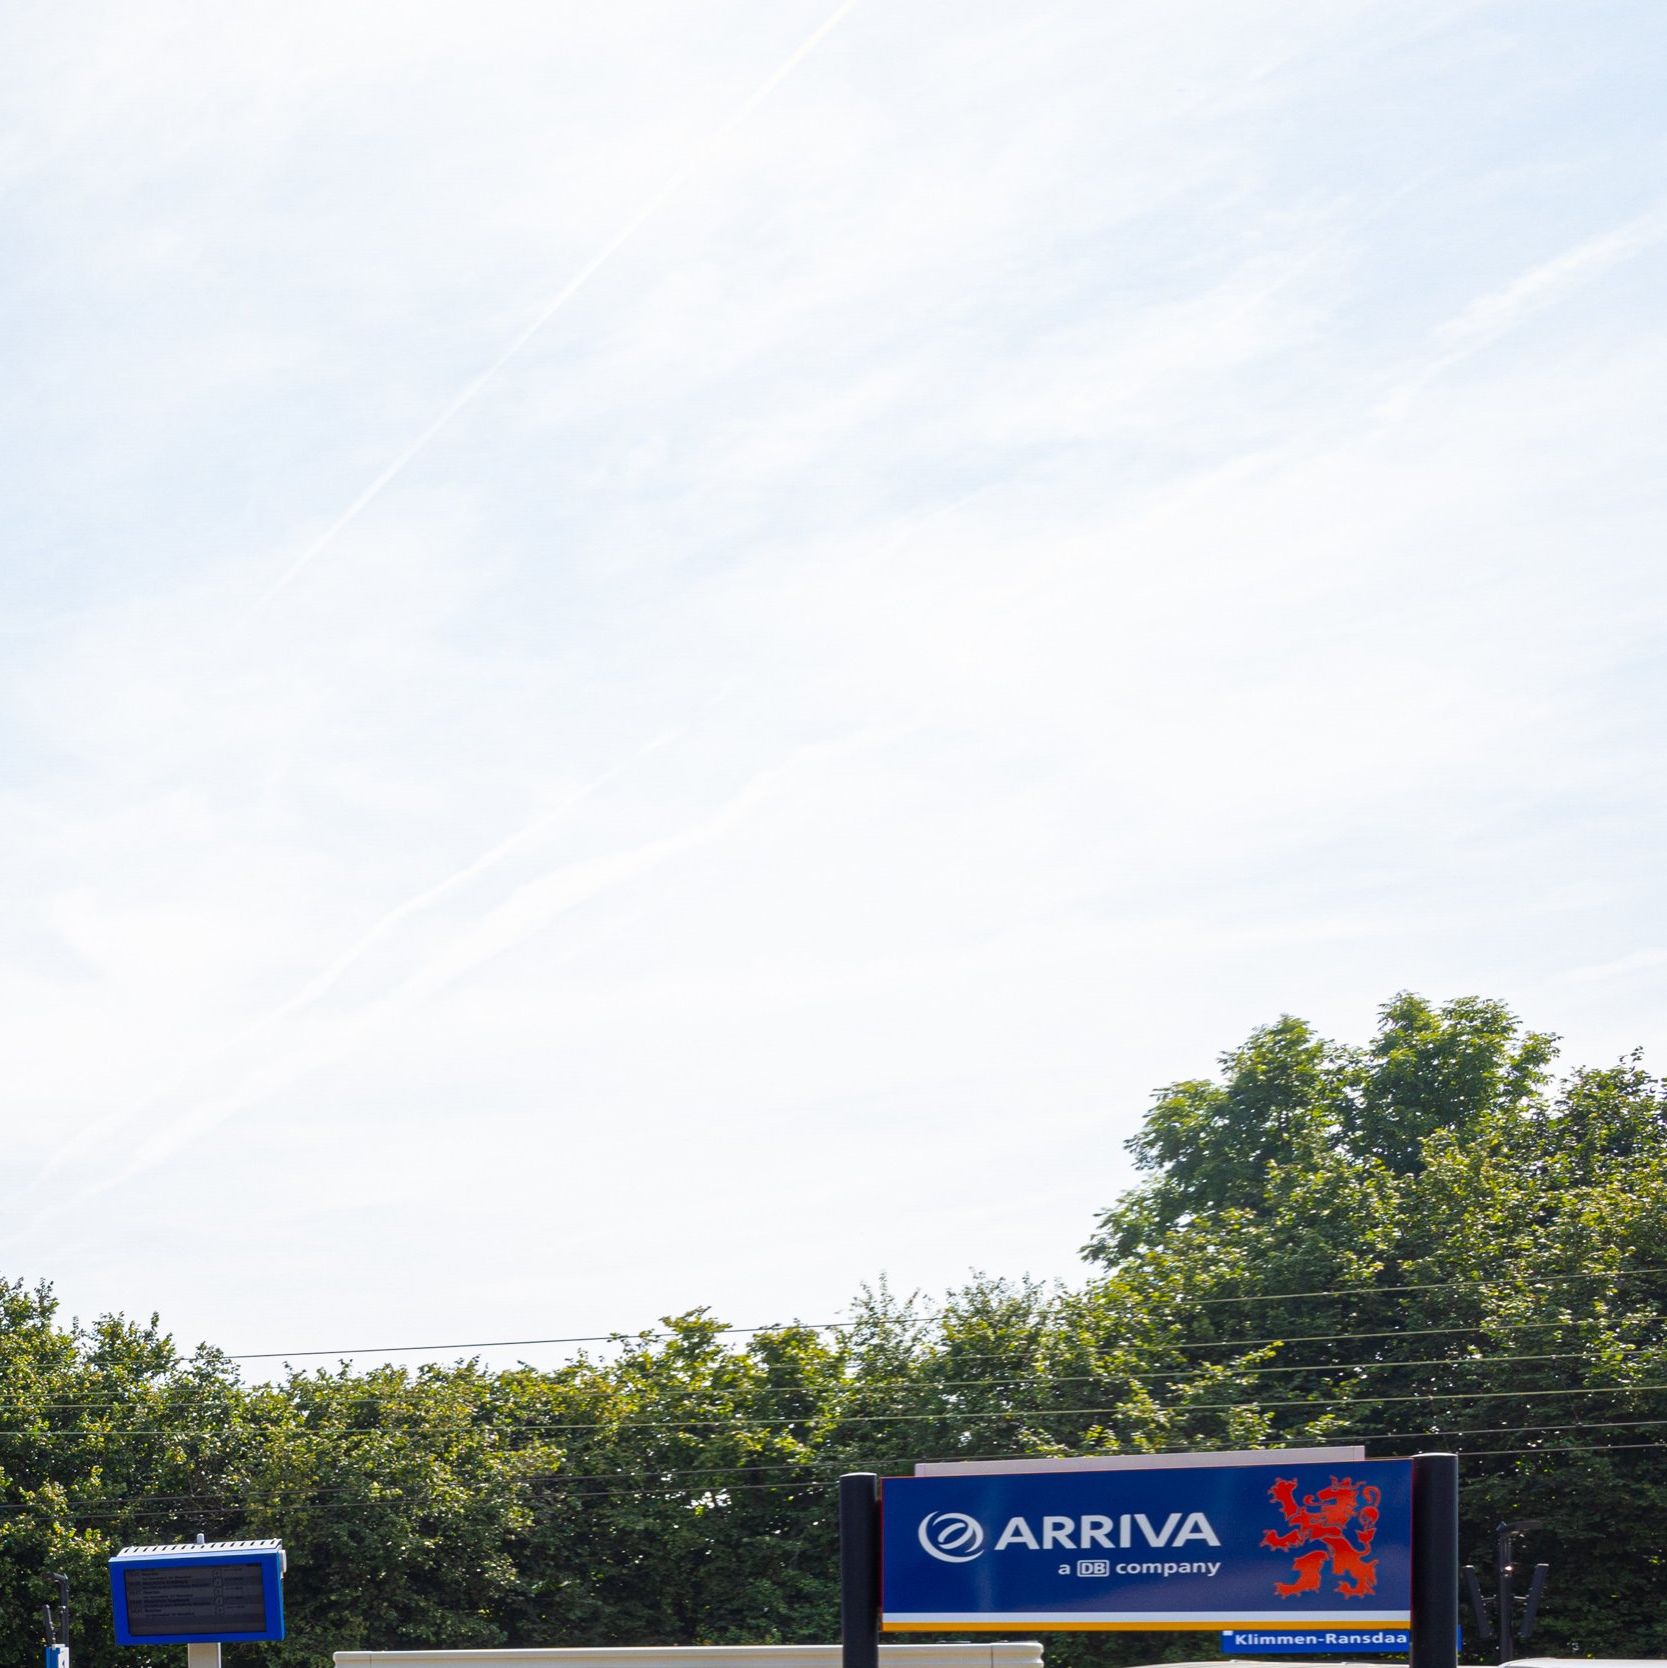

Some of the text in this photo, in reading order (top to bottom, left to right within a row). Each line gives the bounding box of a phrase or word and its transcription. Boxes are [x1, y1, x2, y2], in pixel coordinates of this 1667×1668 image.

[994, 1512, 1221, 1550] ARRIVA
[1058, 1561, 1221, 1577] a DB company
[1235, 1632, 1407, 1646] Klimmen-Ransdaa
